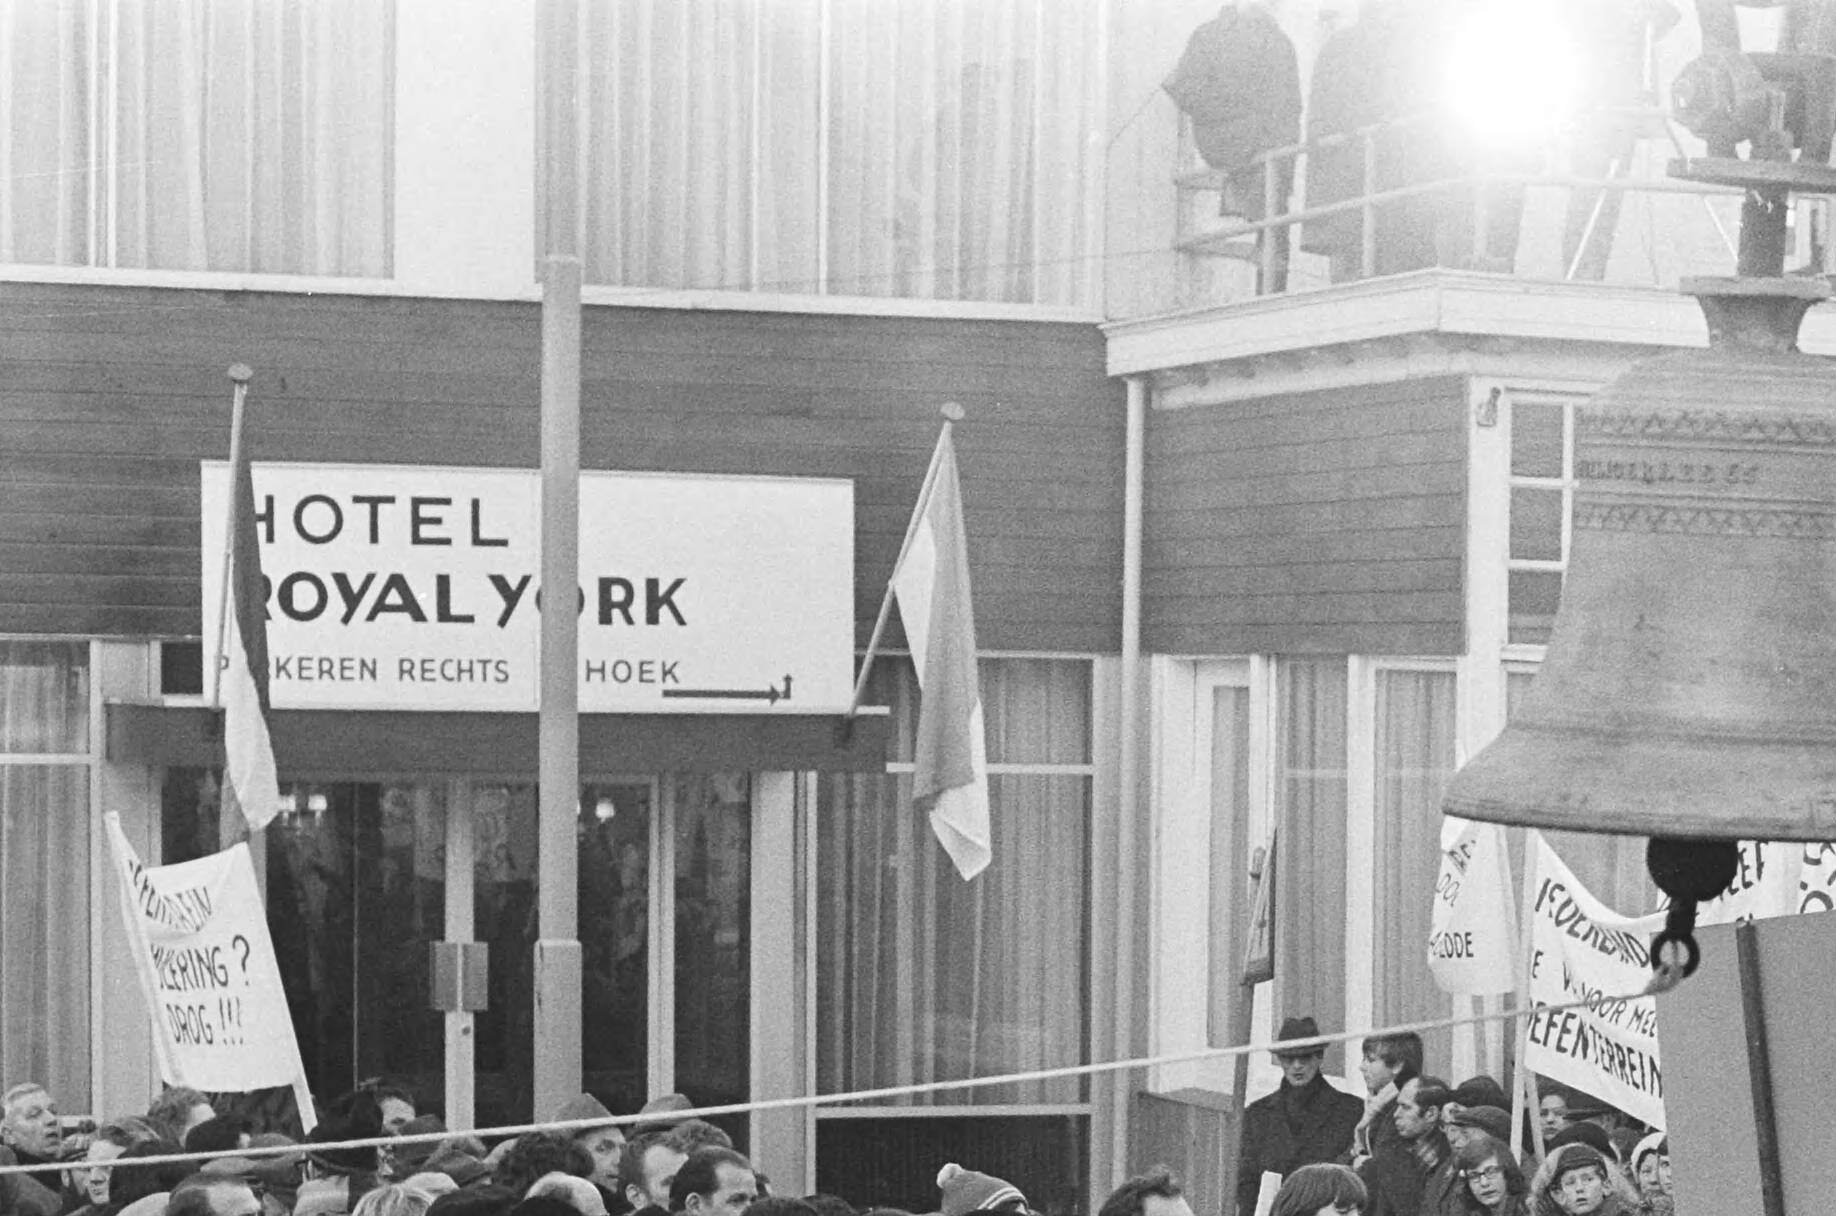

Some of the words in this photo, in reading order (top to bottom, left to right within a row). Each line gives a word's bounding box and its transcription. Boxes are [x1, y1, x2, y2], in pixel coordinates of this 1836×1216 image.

[256, 494, 509, 547] HOTEL
[260, 571, 476, 626] OYAL
[399, 657, 510, 682] RECHTS
[586, 659, 680, 684] HOEK
